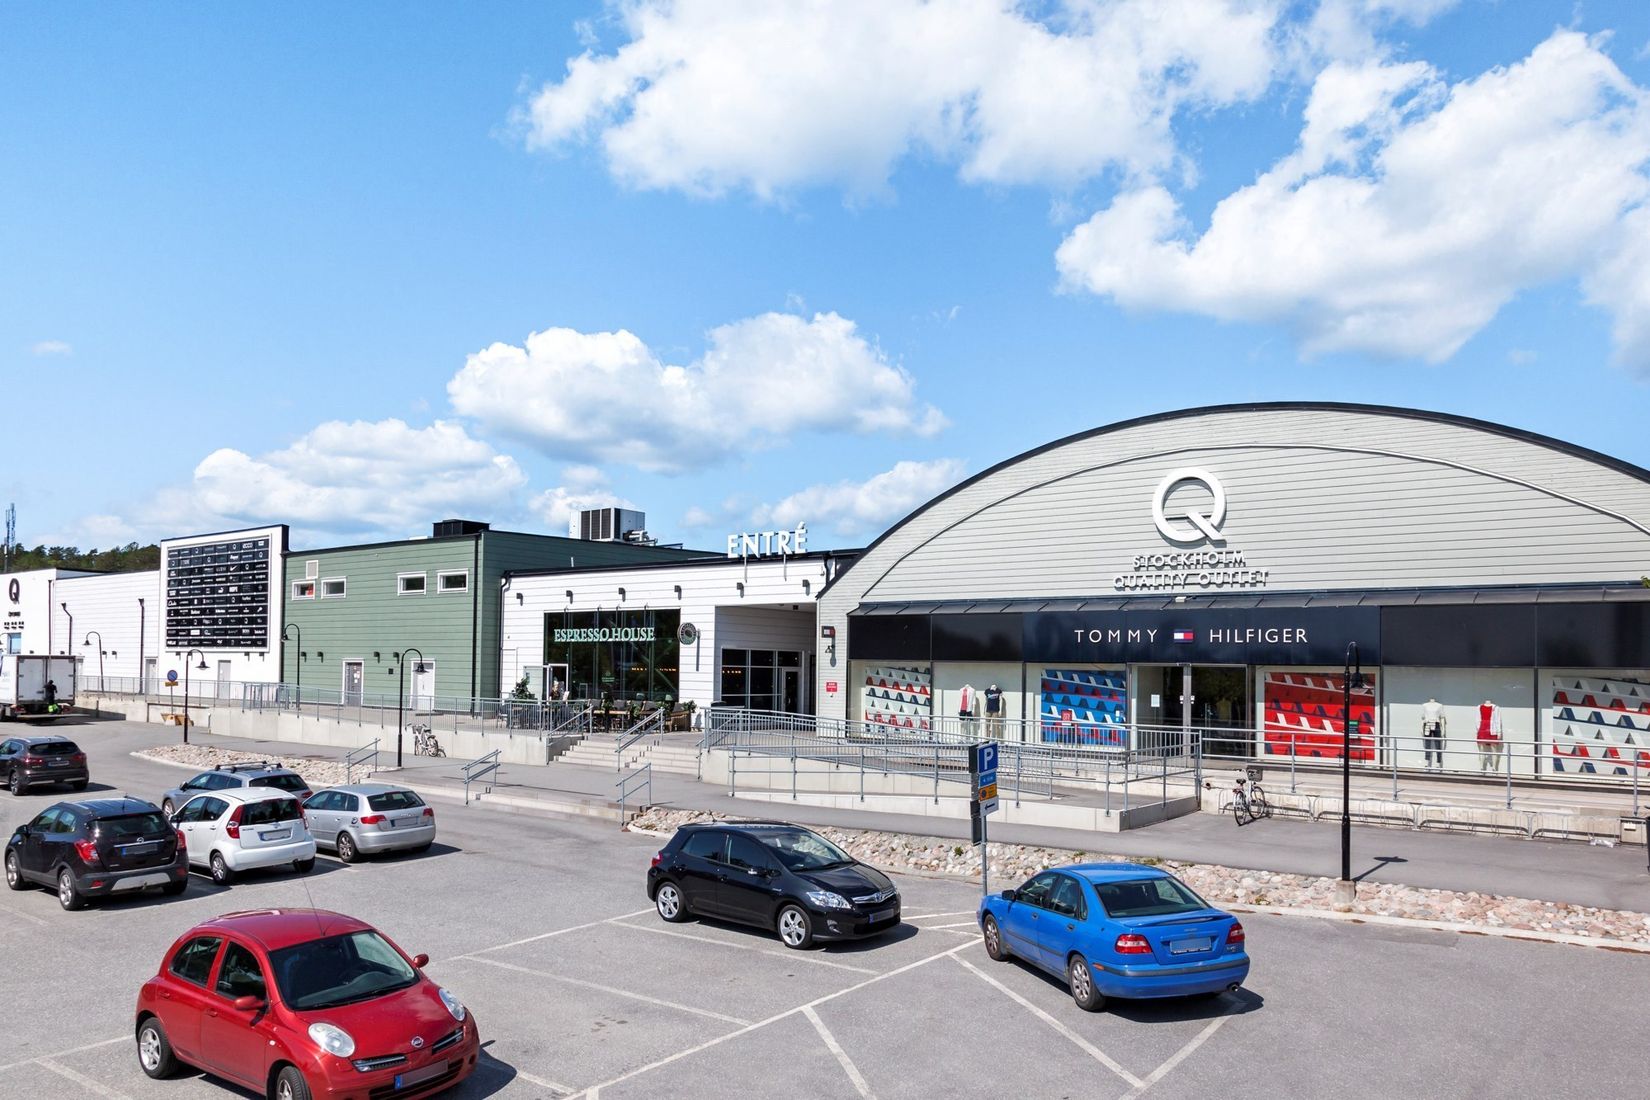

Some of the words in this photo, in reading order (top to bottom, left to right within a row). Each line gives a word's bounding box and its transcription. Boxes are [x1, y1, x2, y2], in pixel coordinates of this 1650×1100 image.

[1152, 467, 1226, 547] Q
[728, 521, 806, 559] ENTRÉ
[1132, 551, 1246, 570] STOCKHOLM
[1113, 573, 1187, 590] QUALITY
[1198, 571, 1269, 588] OUTLET
[554, 628, 610, 642] ESPRESSO
[611, 627, 656, 642] HOUSE
[1074, 629, 1159, 644] TOMMY
[1209, 628, 1309, 644] HILFIGER
[984, 748, 994, 770] P
